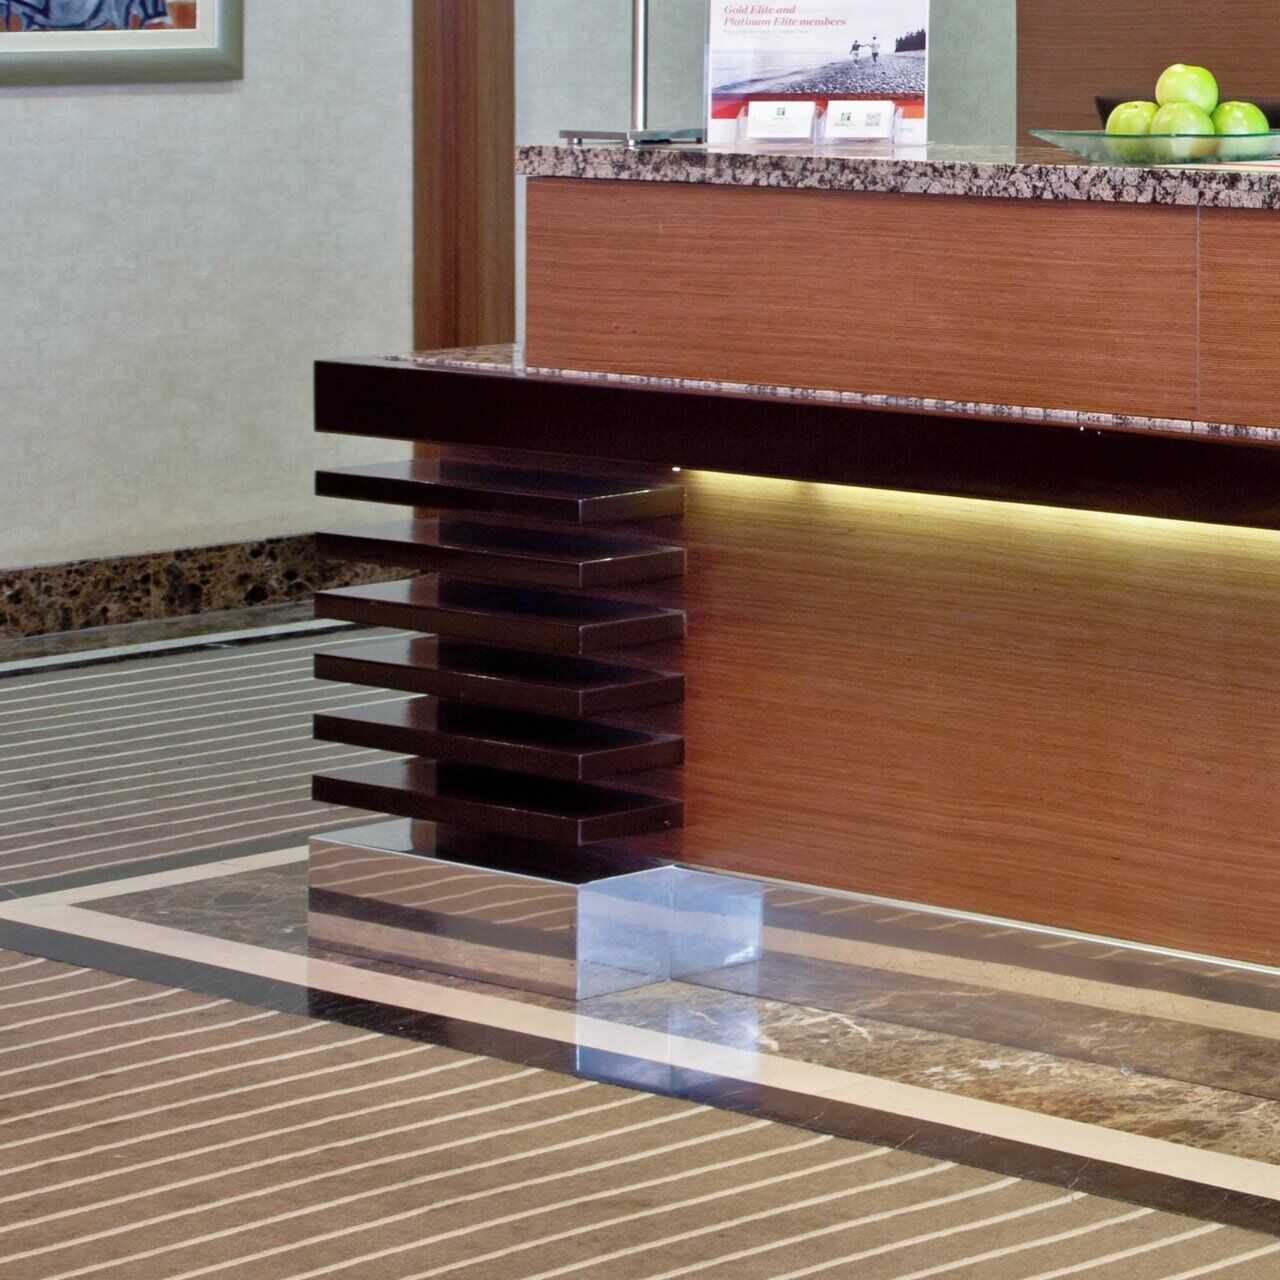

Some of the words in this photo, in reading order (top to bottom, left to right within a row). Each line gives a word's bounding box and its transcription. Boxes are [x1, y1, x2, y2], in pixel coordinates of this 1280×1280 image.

[723, 4, 749, 14] Gold
[750, 4, 775, 14] Elite
[776, 4, 797, 14] and
[723, 17, 771, 26] Platinum
[773, 17, 798, 26] Elite
[799, 17, 848, 26] members
